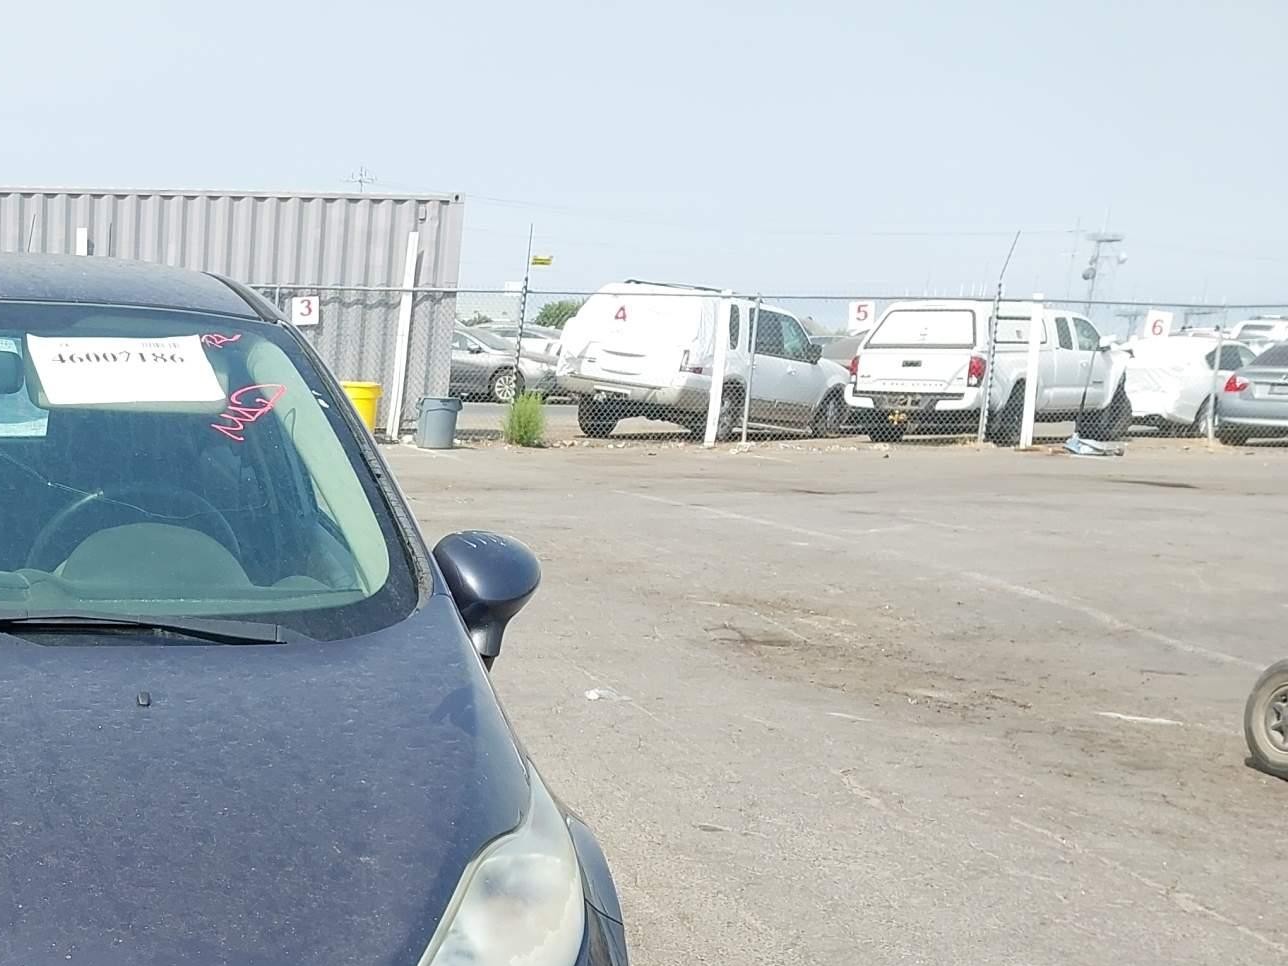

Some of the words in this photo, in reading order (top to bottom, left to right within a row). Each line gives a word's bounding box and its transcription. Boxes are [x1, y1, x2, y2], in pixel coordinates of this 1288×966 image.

[299, 299, 312, 317] 3
[856, 304, 868, 321] 5
[1151, 319, 1164, 336] 6
[51, 350, 185, 363] 46007186
